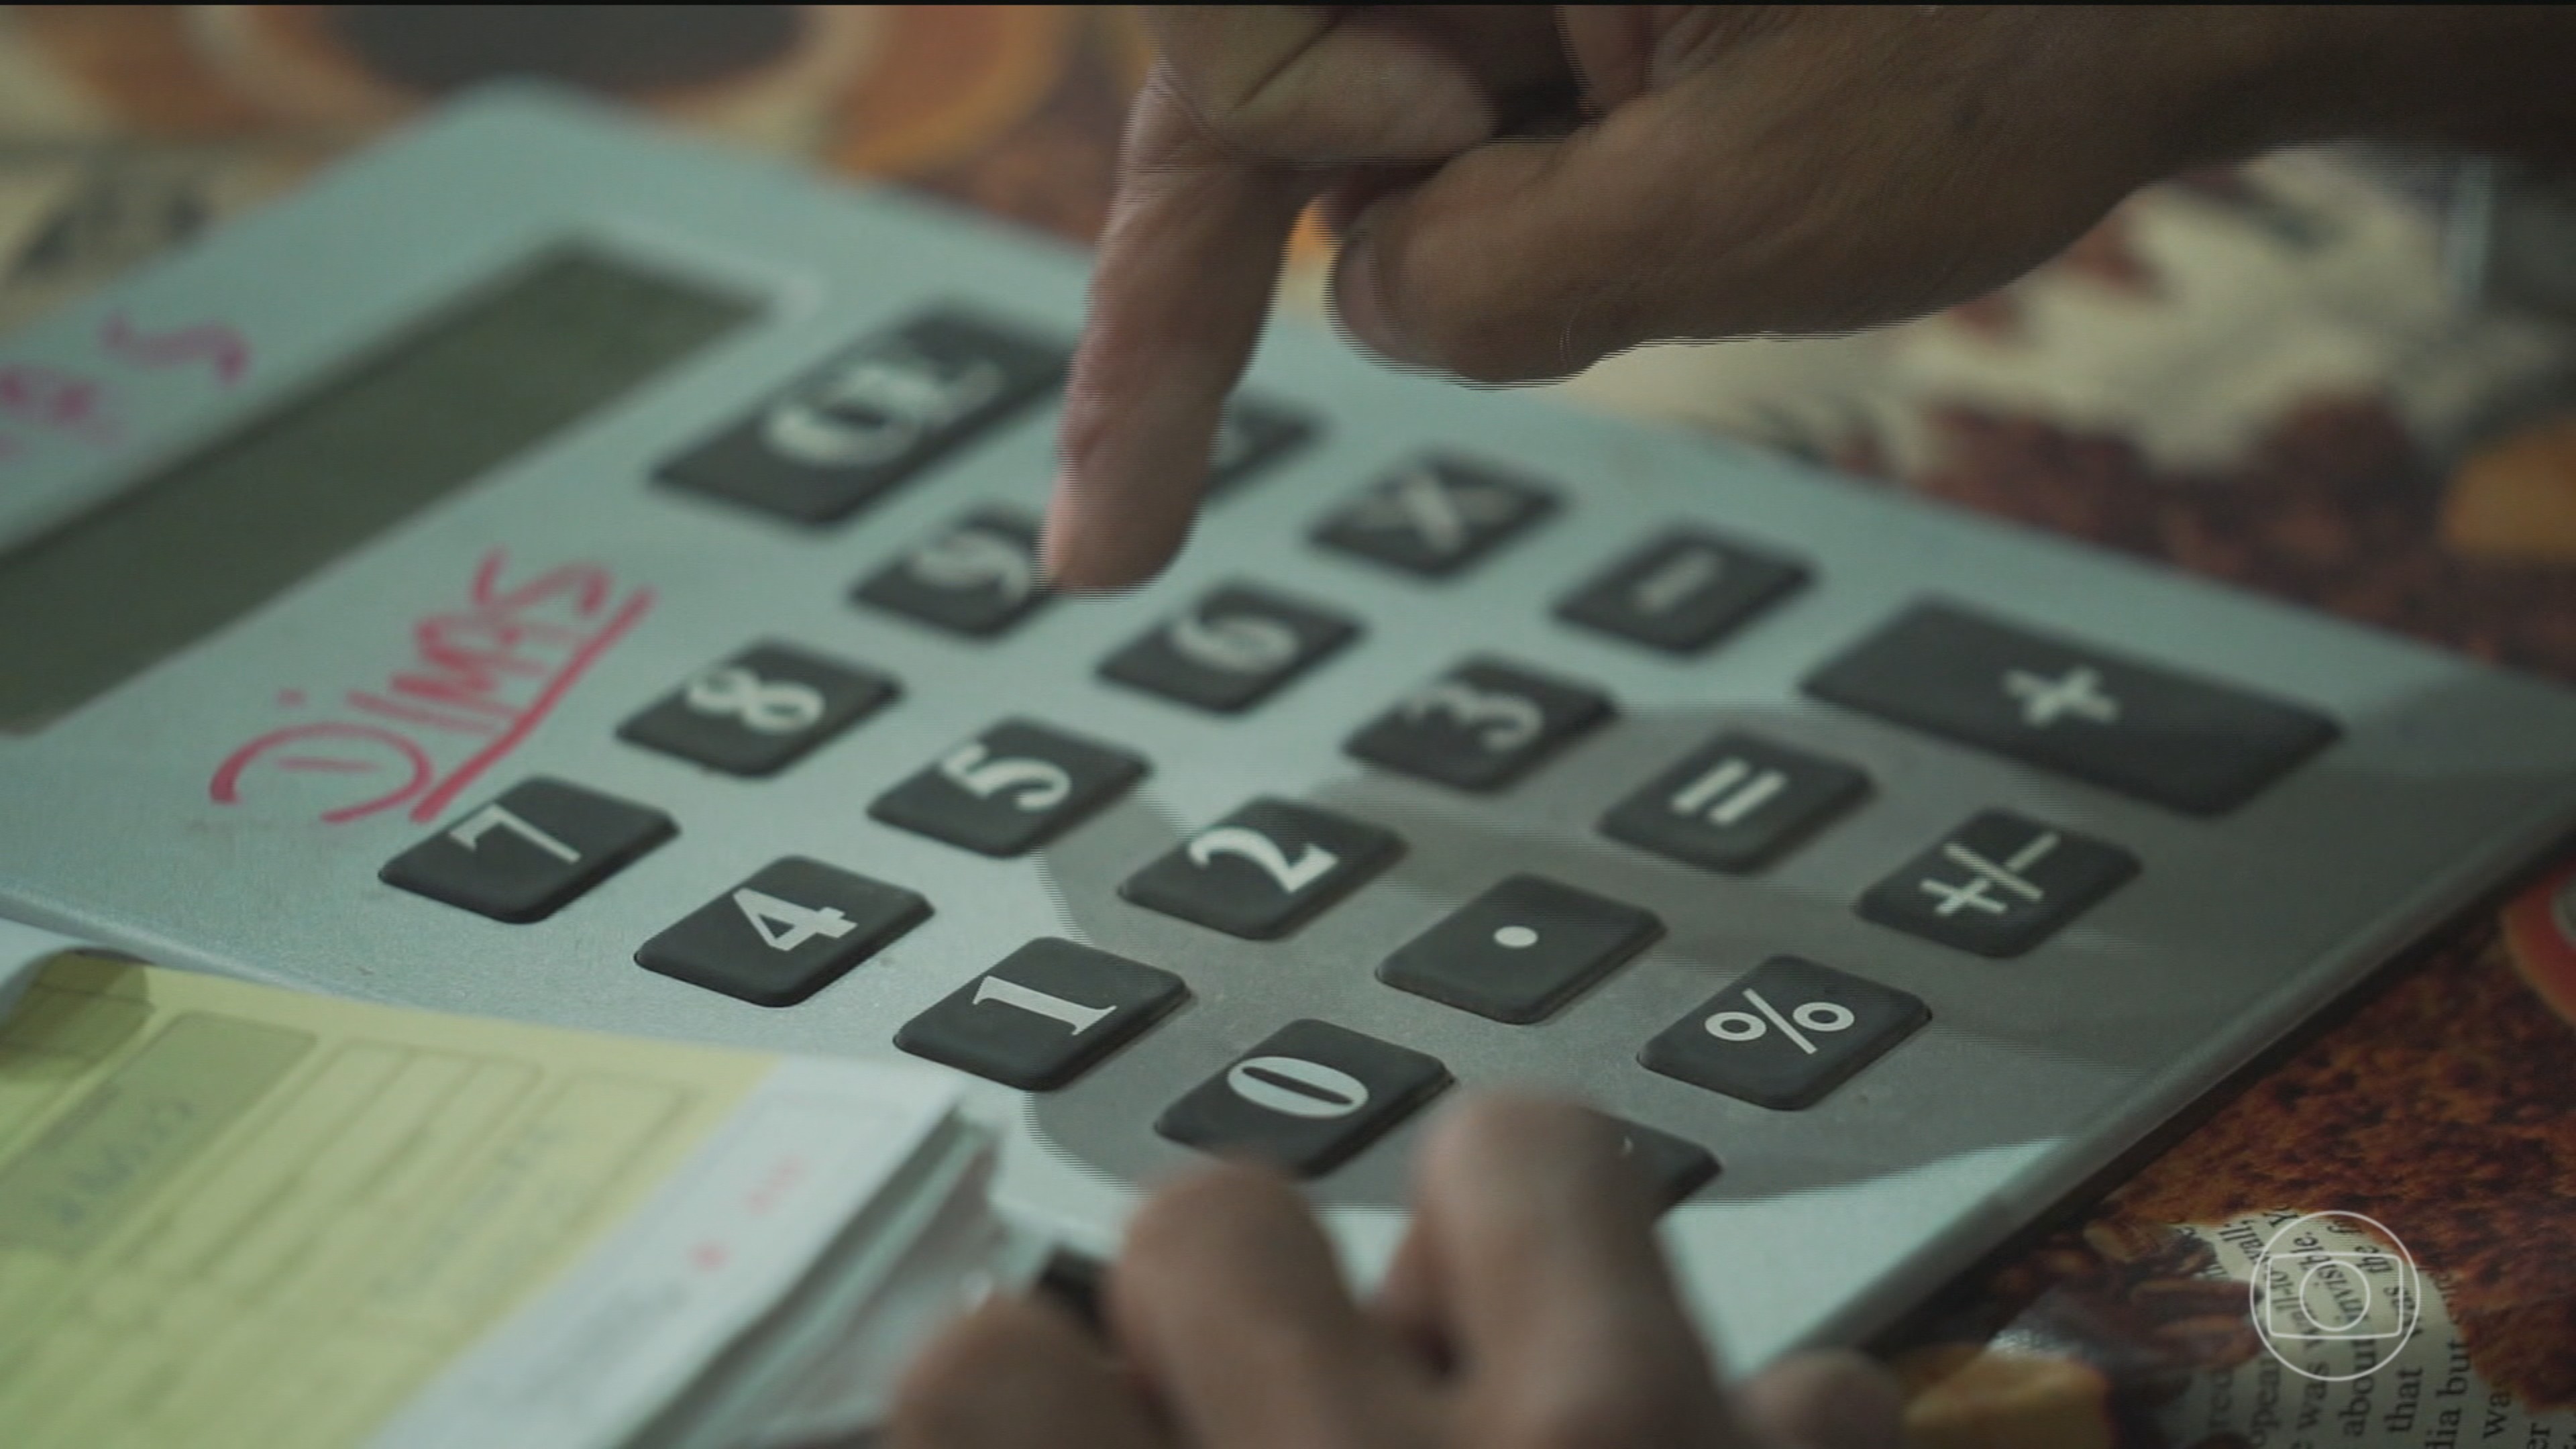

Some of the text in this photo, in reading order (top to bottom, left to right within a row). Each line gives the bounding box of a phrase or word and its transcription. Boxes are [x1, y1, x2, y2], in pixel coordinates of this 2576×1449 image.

[1169, 612, 1301, 672] 6
[683, 664, 829, 734] 8
[1397, 678, 1548, 753] 3
[941, 739, 1073, 810] 5
[1669, 753, 1790, 828] =
[447, 802, 582, 865] 7
[1187, 825, 1340, 895] 2
[731, 885, 859, 953] 4
[971, 974, 1118, 1036] 1
[1703, 987, 1856, 1055] %
[1226, 1055, 1370, 1119] 0
[2297, 1360, 2329, 1432] was
[2339, 1338, 2377, 1438] about
[2383, 1367, 2424, 1434] that
[2436, 1339, 2471, 1397] but
